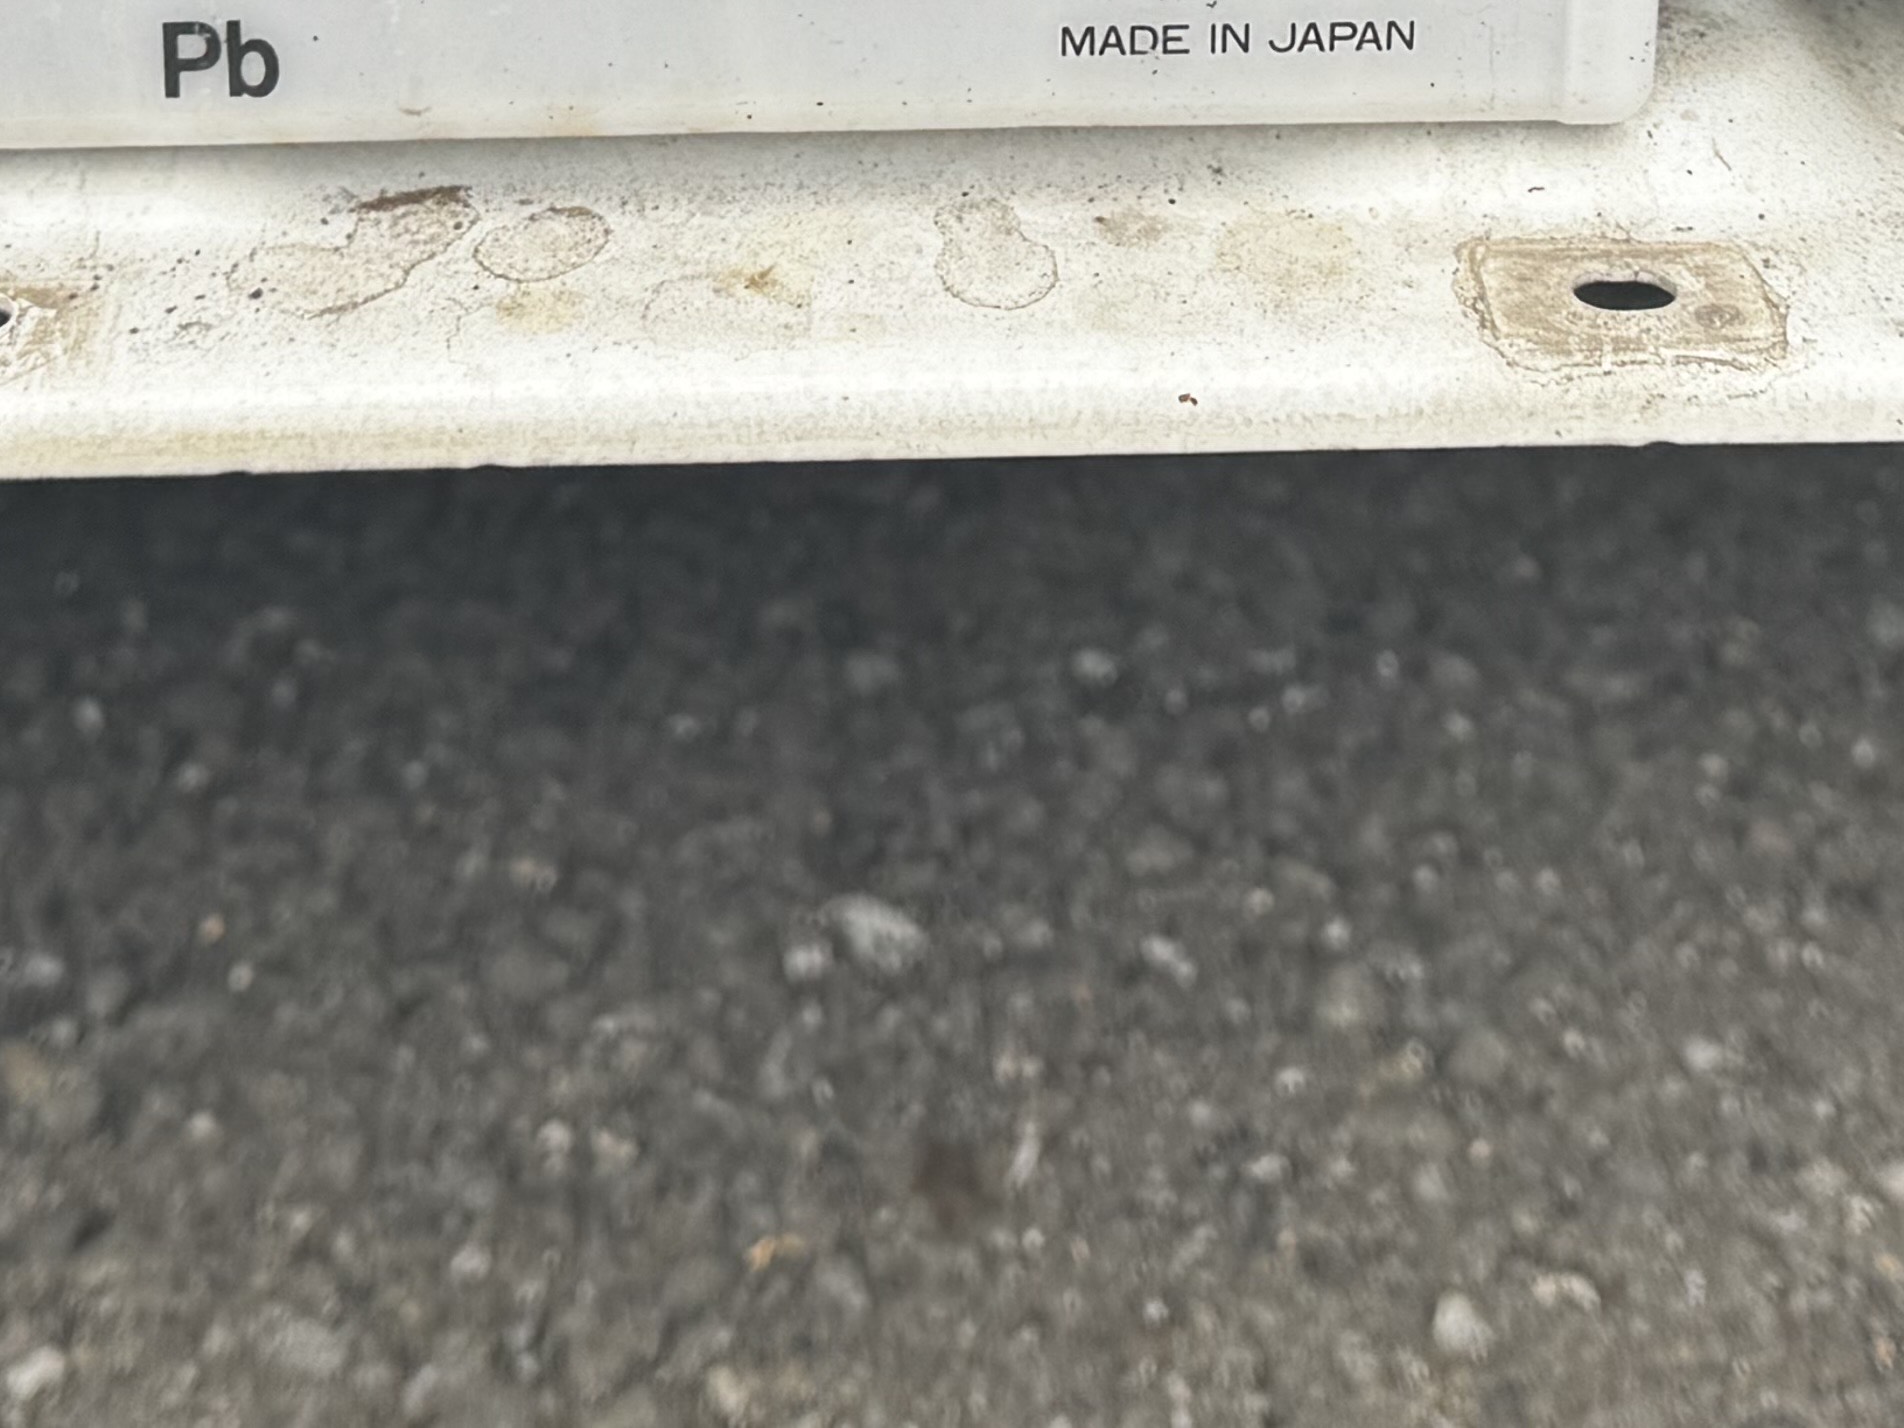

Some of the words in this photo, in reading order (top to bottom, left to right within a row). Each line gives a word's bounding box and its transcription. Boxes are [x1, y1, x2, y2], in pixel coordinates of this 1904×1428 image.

[161, 20, 281, 99] Pb
[1061, 23, 1190, 57] MADE
[1211, 22, 1250, 55] IN
[1268, 20, 1416, 53] JAPAN
